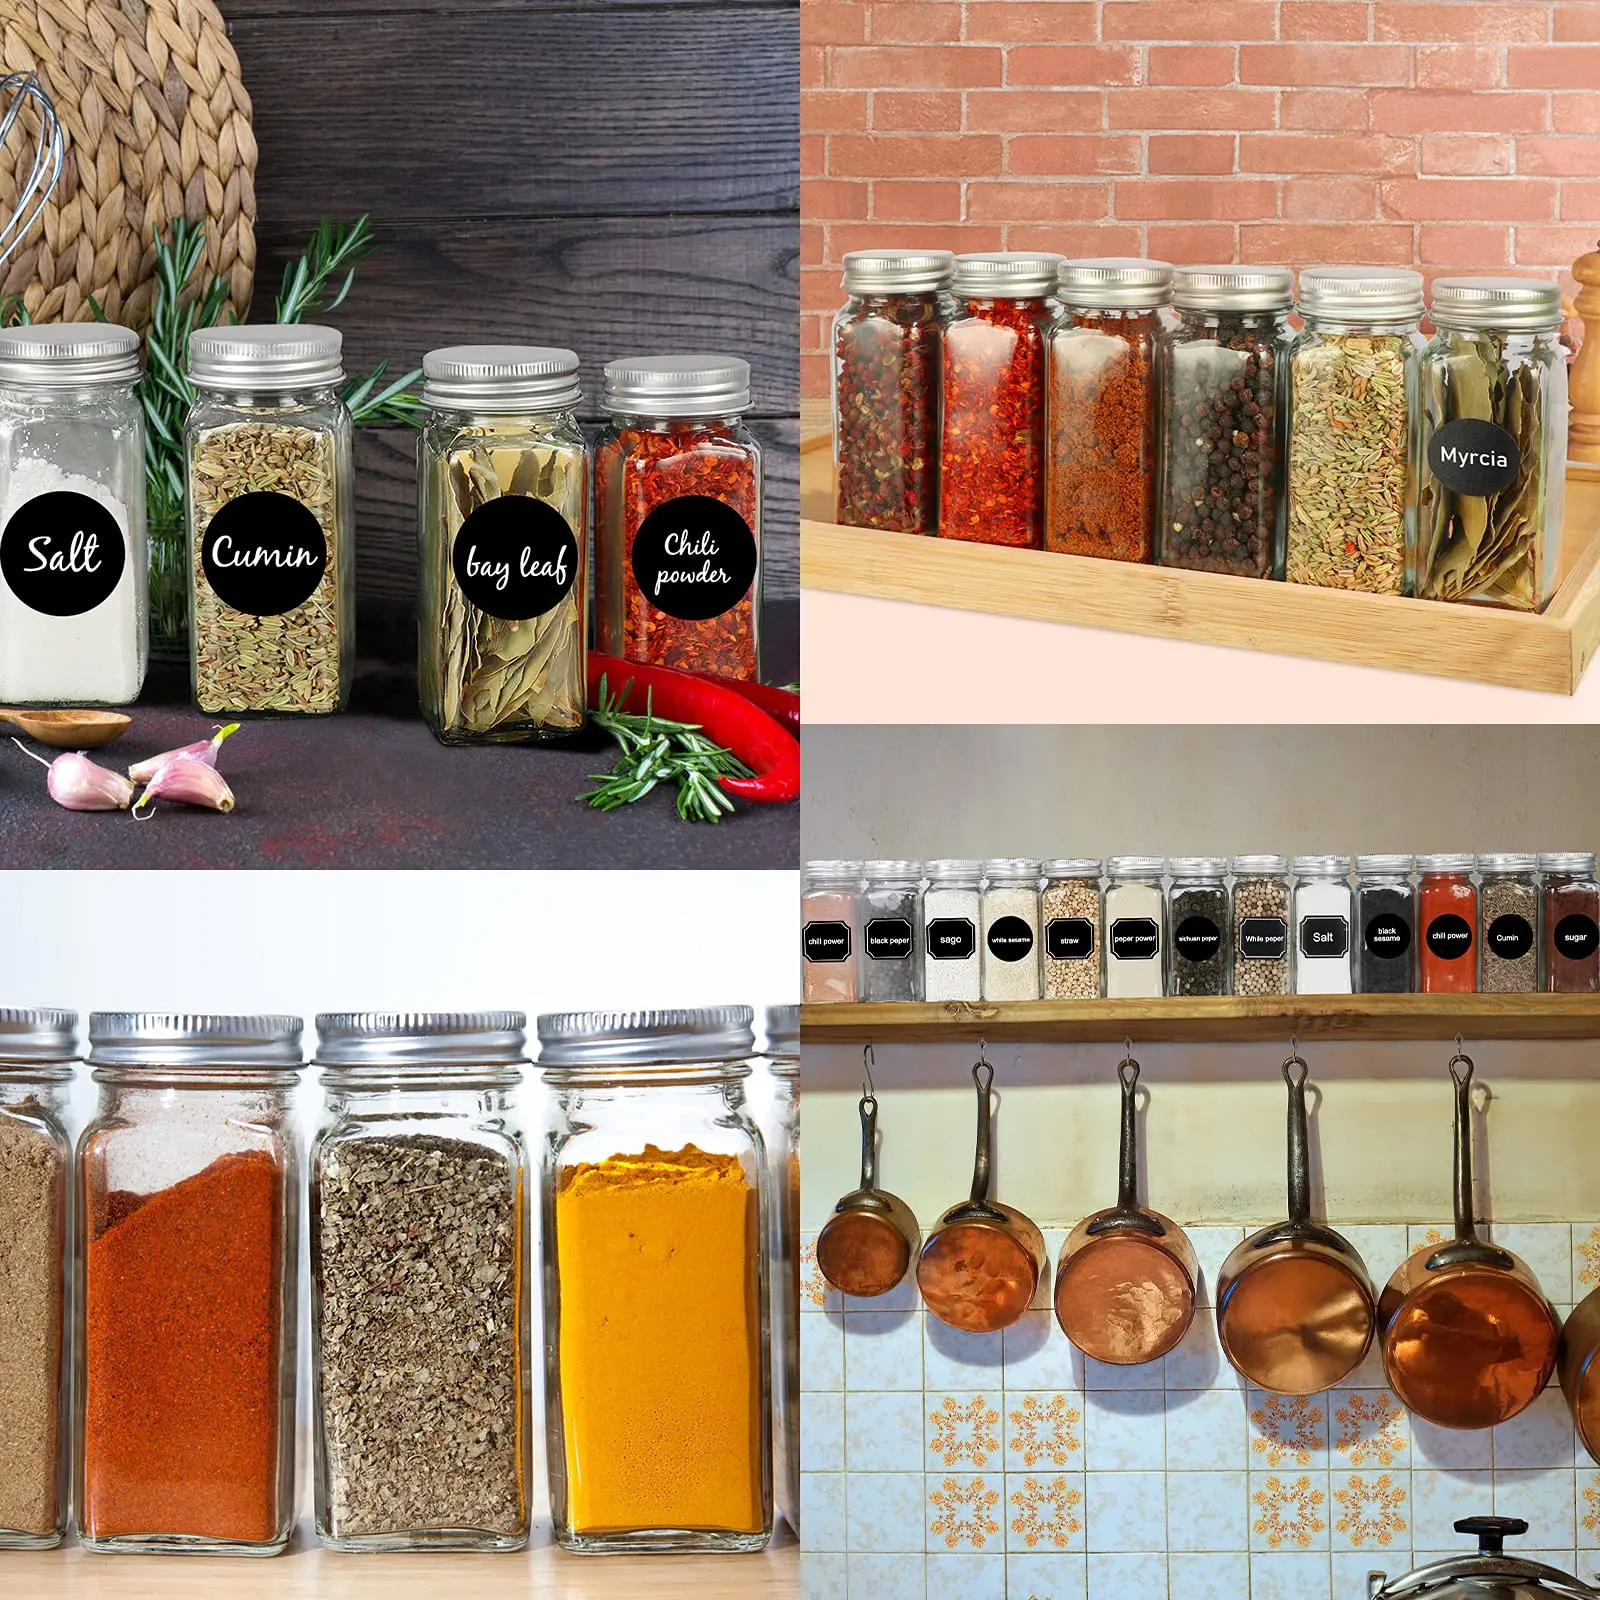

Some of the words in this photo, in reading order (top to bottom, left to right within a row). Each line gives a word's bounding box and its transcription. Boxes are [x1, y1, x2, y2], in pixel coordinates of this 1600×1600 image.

[1440, 445, 1508, 468] Myrcia
[664, 528, 720, 556] Chili
[23, 530, 102, 573] Salt
[211, 534, 319, 568] Cumin
[466, 544, 510, 590] bay
[519, 544, 568, 586] leaf
[654, 559, 732, 596] powder
[1377, 927, 1397, 935] black
[870, 937, 889, 945] black
[939, 936, 962, 946] sago
[1060, 937, 1080, 945] straw
[1135, 935, 1156, 943] power
[1312, 931, 1334, 943] Salt
[1447, 932, 1469, 941] power
[1496, 934, 1519, 942] Cumin
[1564, 934, 1588, 943] sugar
[823, 938, 845, 947] power
